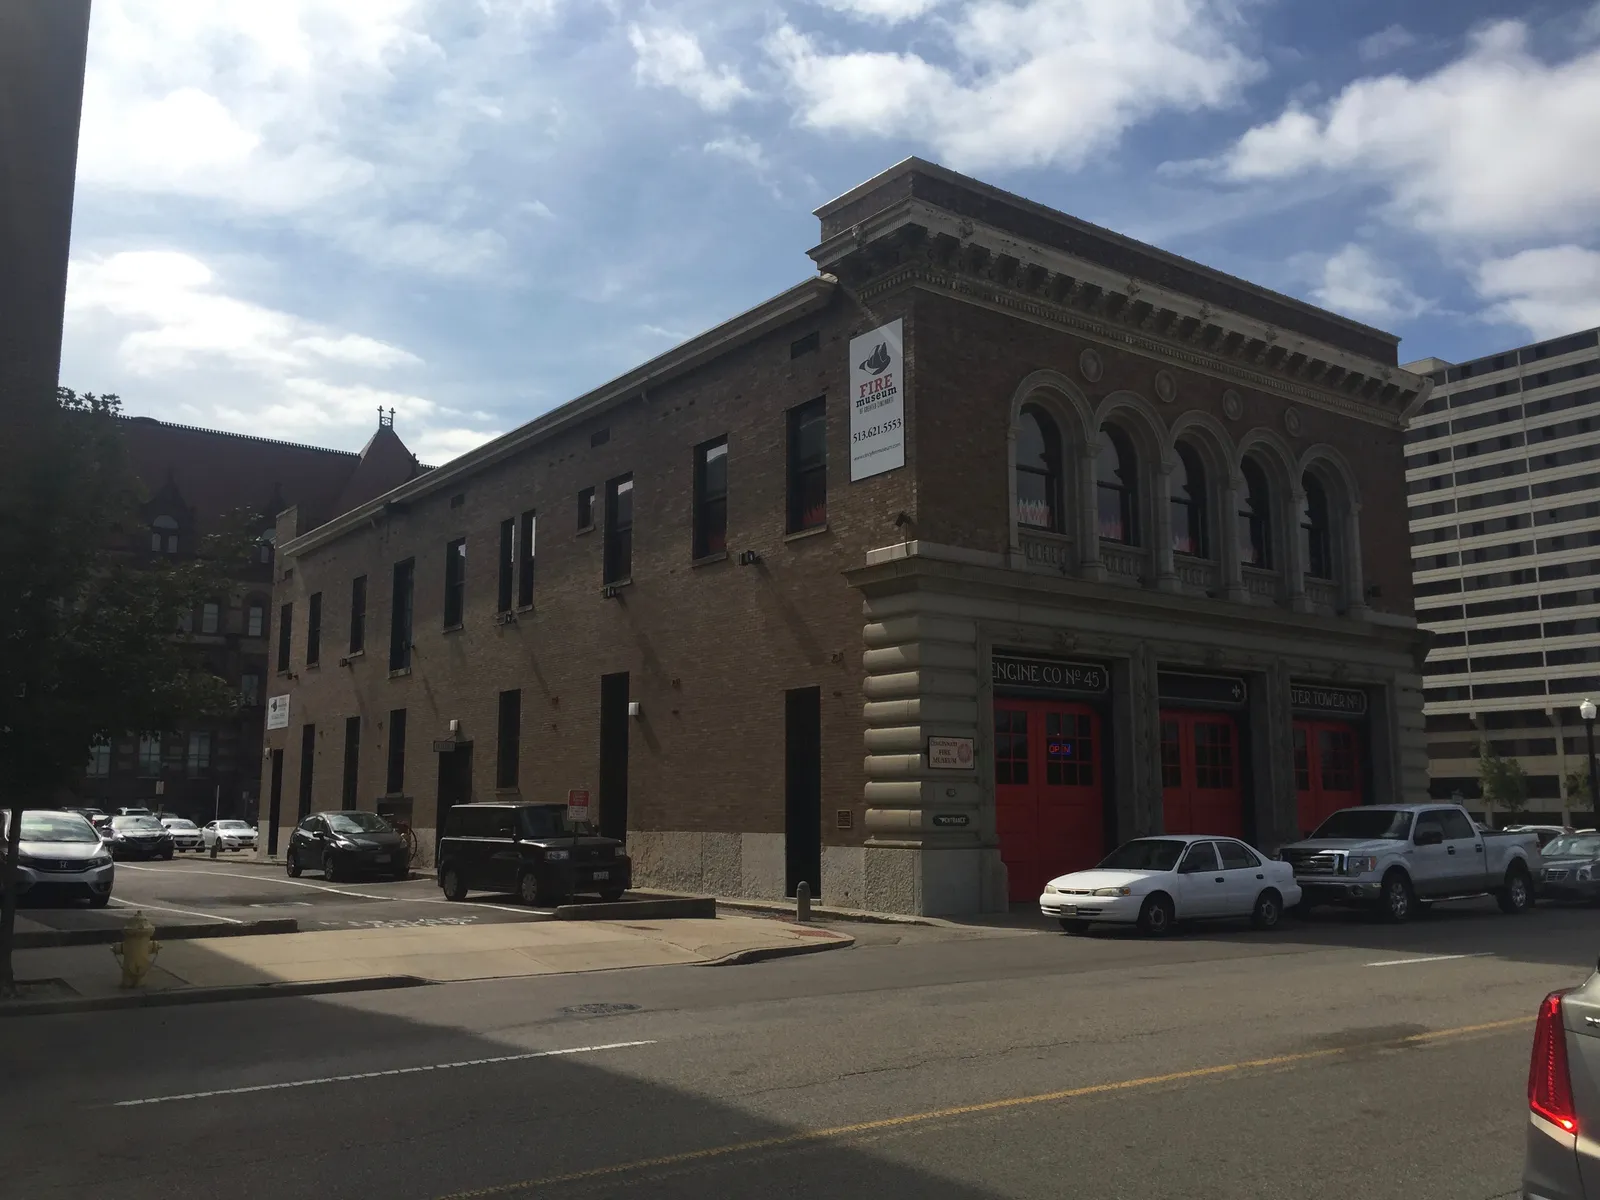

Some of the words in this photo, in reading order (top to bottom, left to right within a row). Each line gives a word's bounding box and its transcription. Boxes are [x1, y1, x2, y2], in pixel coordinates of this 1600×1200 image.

[856, 386, 897, 408] museum
[859, 373, 893, 399] FIRE
[853, 418, 902, 444] 513.621.5553
[1043, 666, 1062, 683] CO
[1084, 671, 1100, 688] 45
[1312, 691, 1345, 708] TOWER
